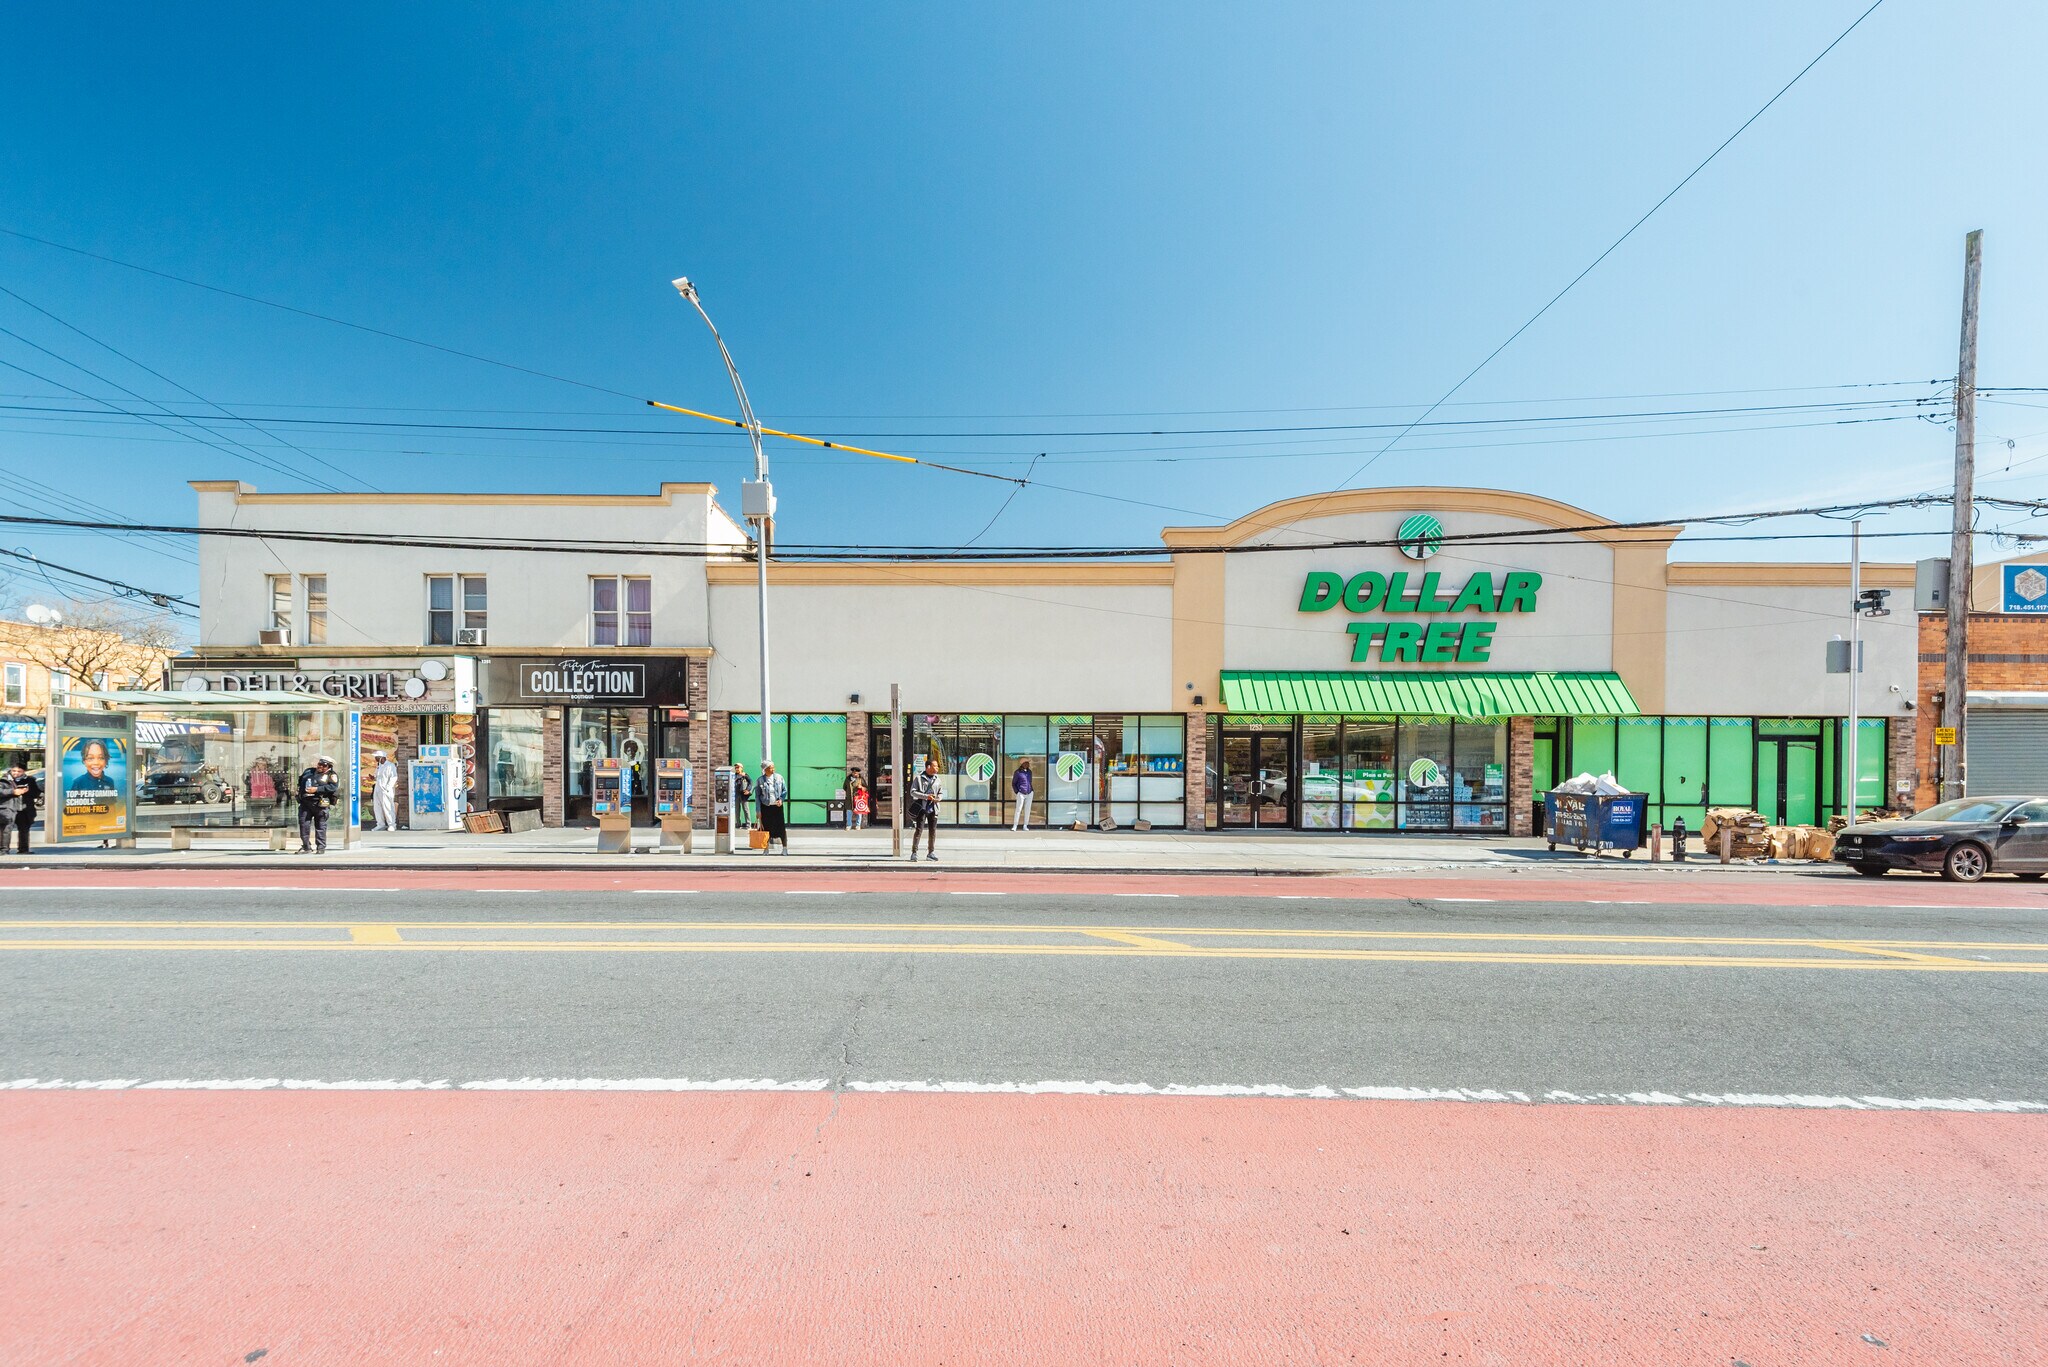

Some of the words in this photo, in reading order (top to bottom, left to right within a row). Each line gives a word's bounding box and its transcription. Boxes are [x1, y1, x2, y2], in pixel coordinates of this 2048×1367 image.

[1298, 571, 1543, 613] DOLLAR
[1346, 622, 1498, 662] TREE
[558, 659, 584, 671] Fifty
[584, 659, 608, 670] Two
[290, 673, 312, 693] &
[319, 673, 398, 698] GRILL
[531, 671, 634, 693] COLLECTION
[366, 704, 404, 712] CIGARETTES
[421, 747, 449, 756] ICE
[65, 790, 118, 798] TOP-PERFORMING
[65, 798, 96, 806] SCHOOLS.
